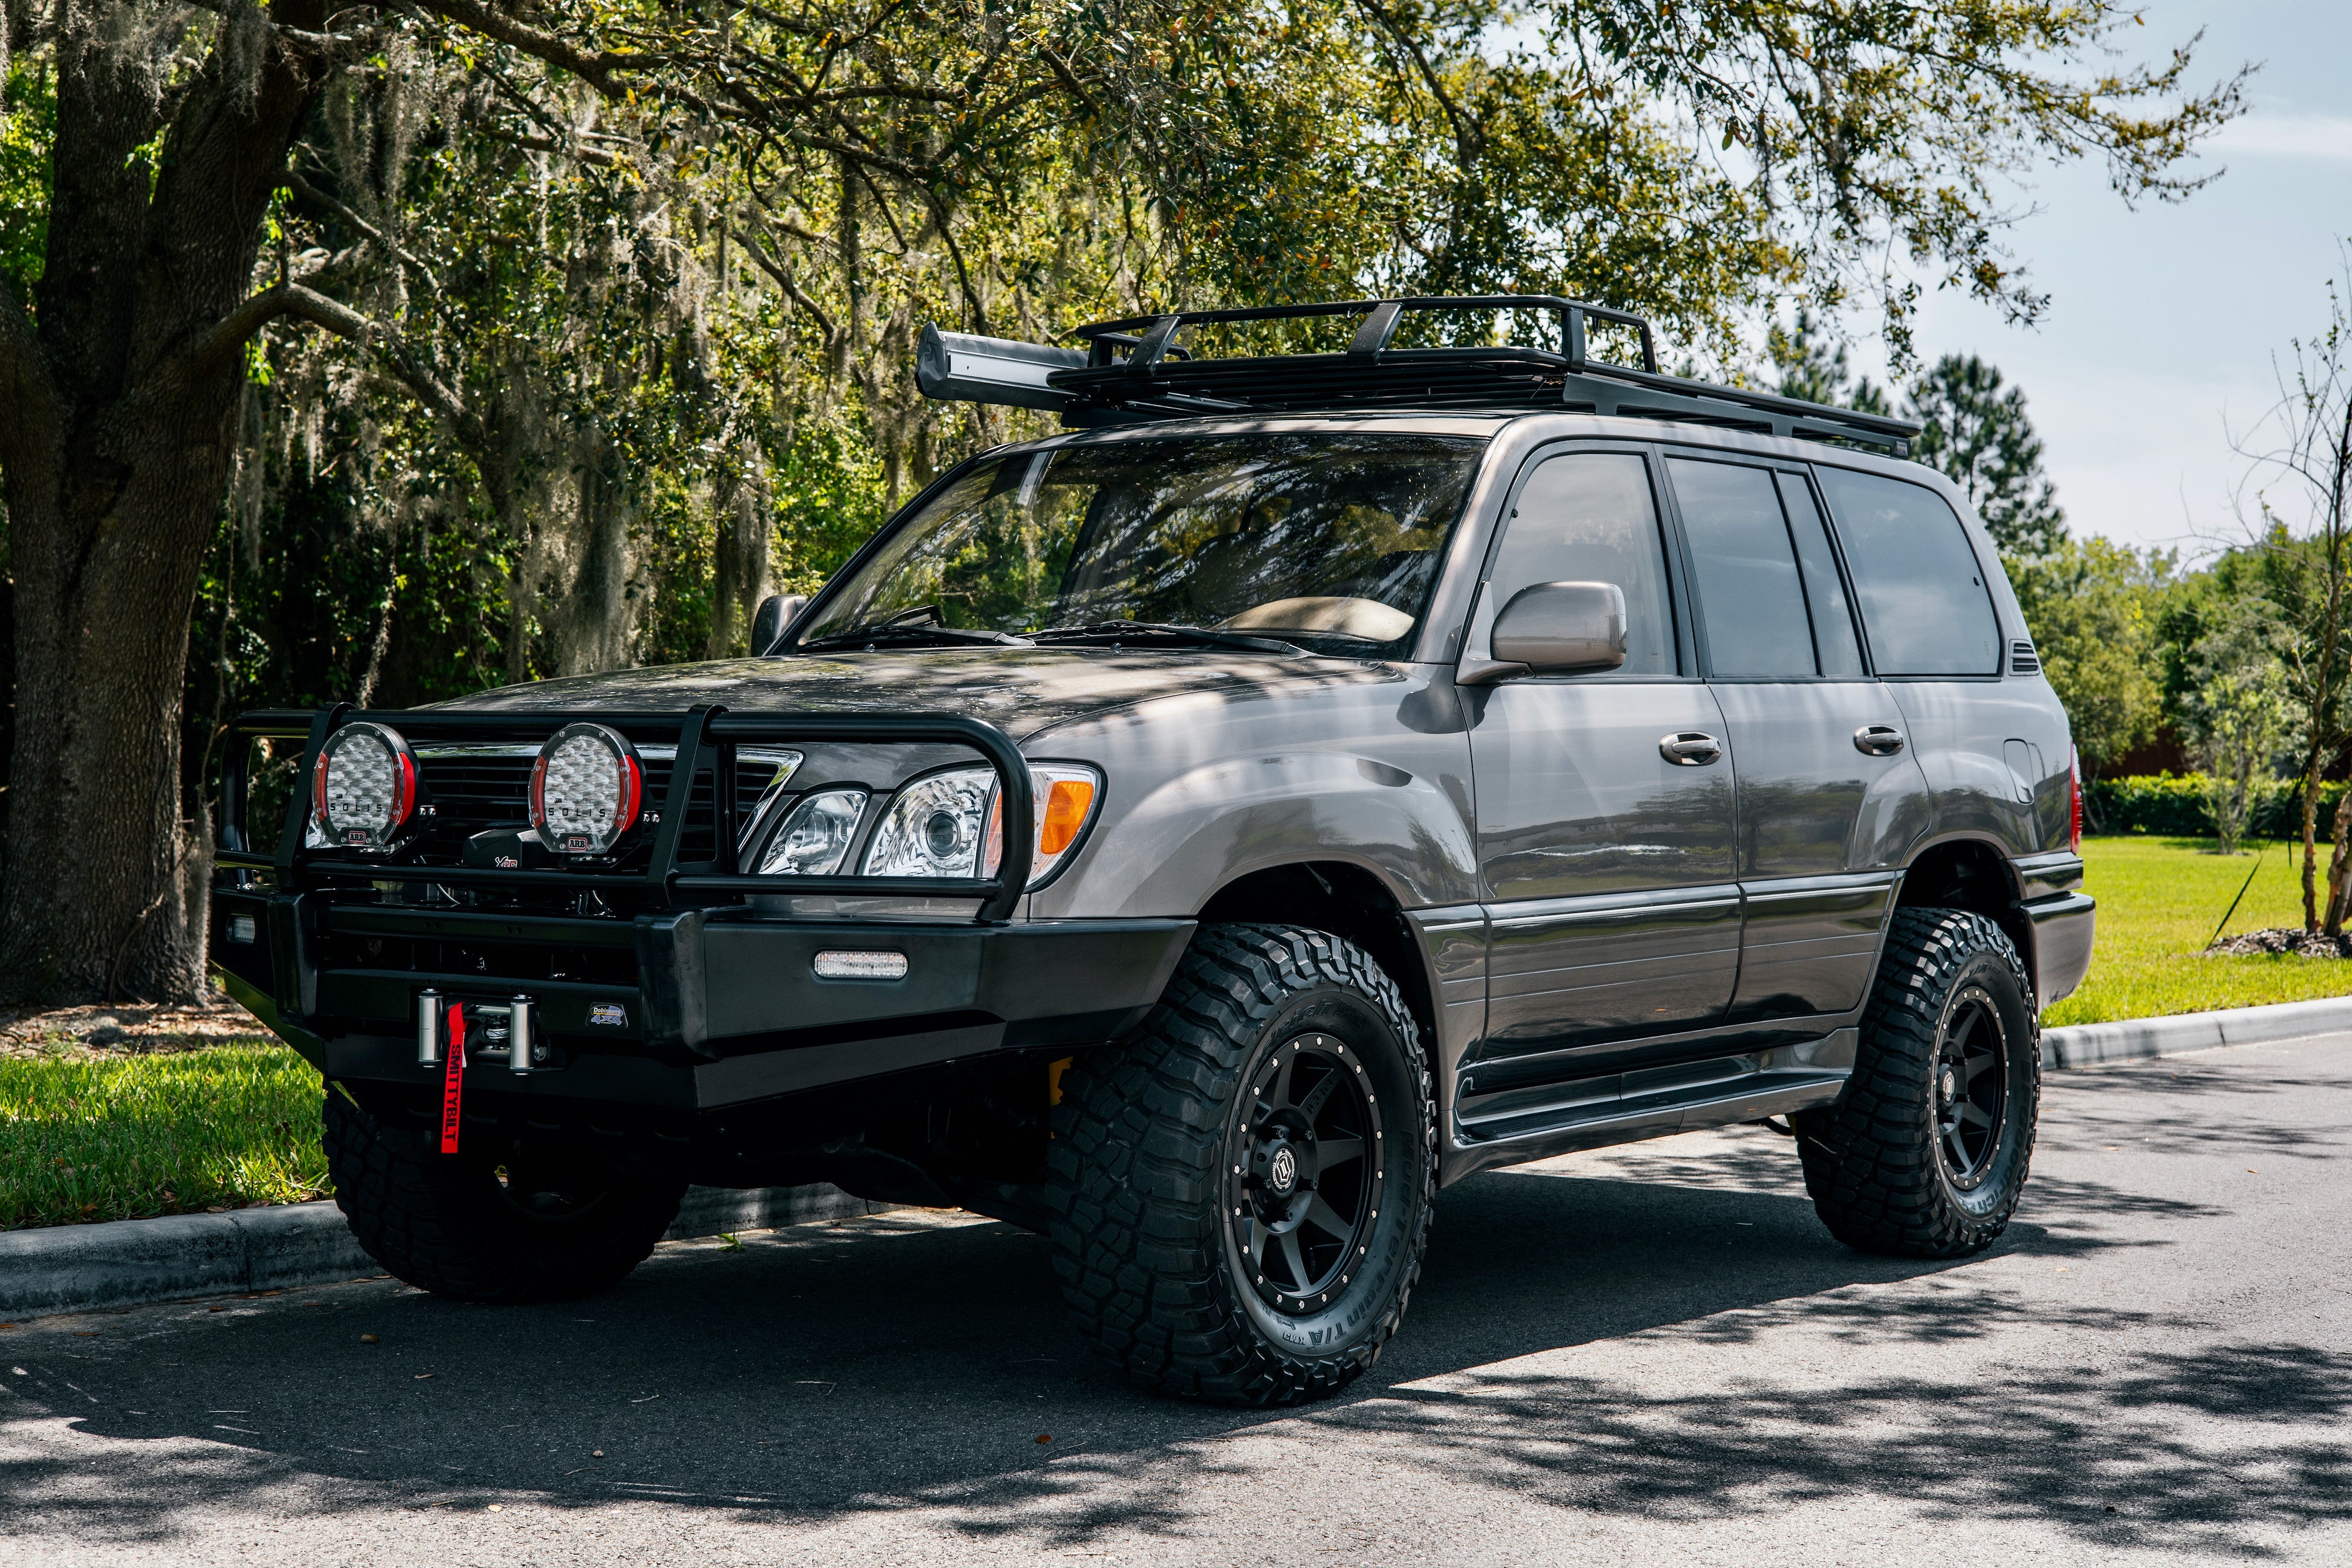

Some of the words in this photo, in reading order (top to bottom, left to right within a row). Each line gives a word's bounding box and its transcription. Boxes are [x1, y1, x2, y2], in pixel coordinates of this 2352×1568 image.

[330, 803, 382, 812] SOLIS
[548, 807, 606, 817] SOLIS
[349, 833, 365, 842] ARB
[569, 839, 586, 848] ARB
[445, 1044, 461, 1142] SMITTYBILT
